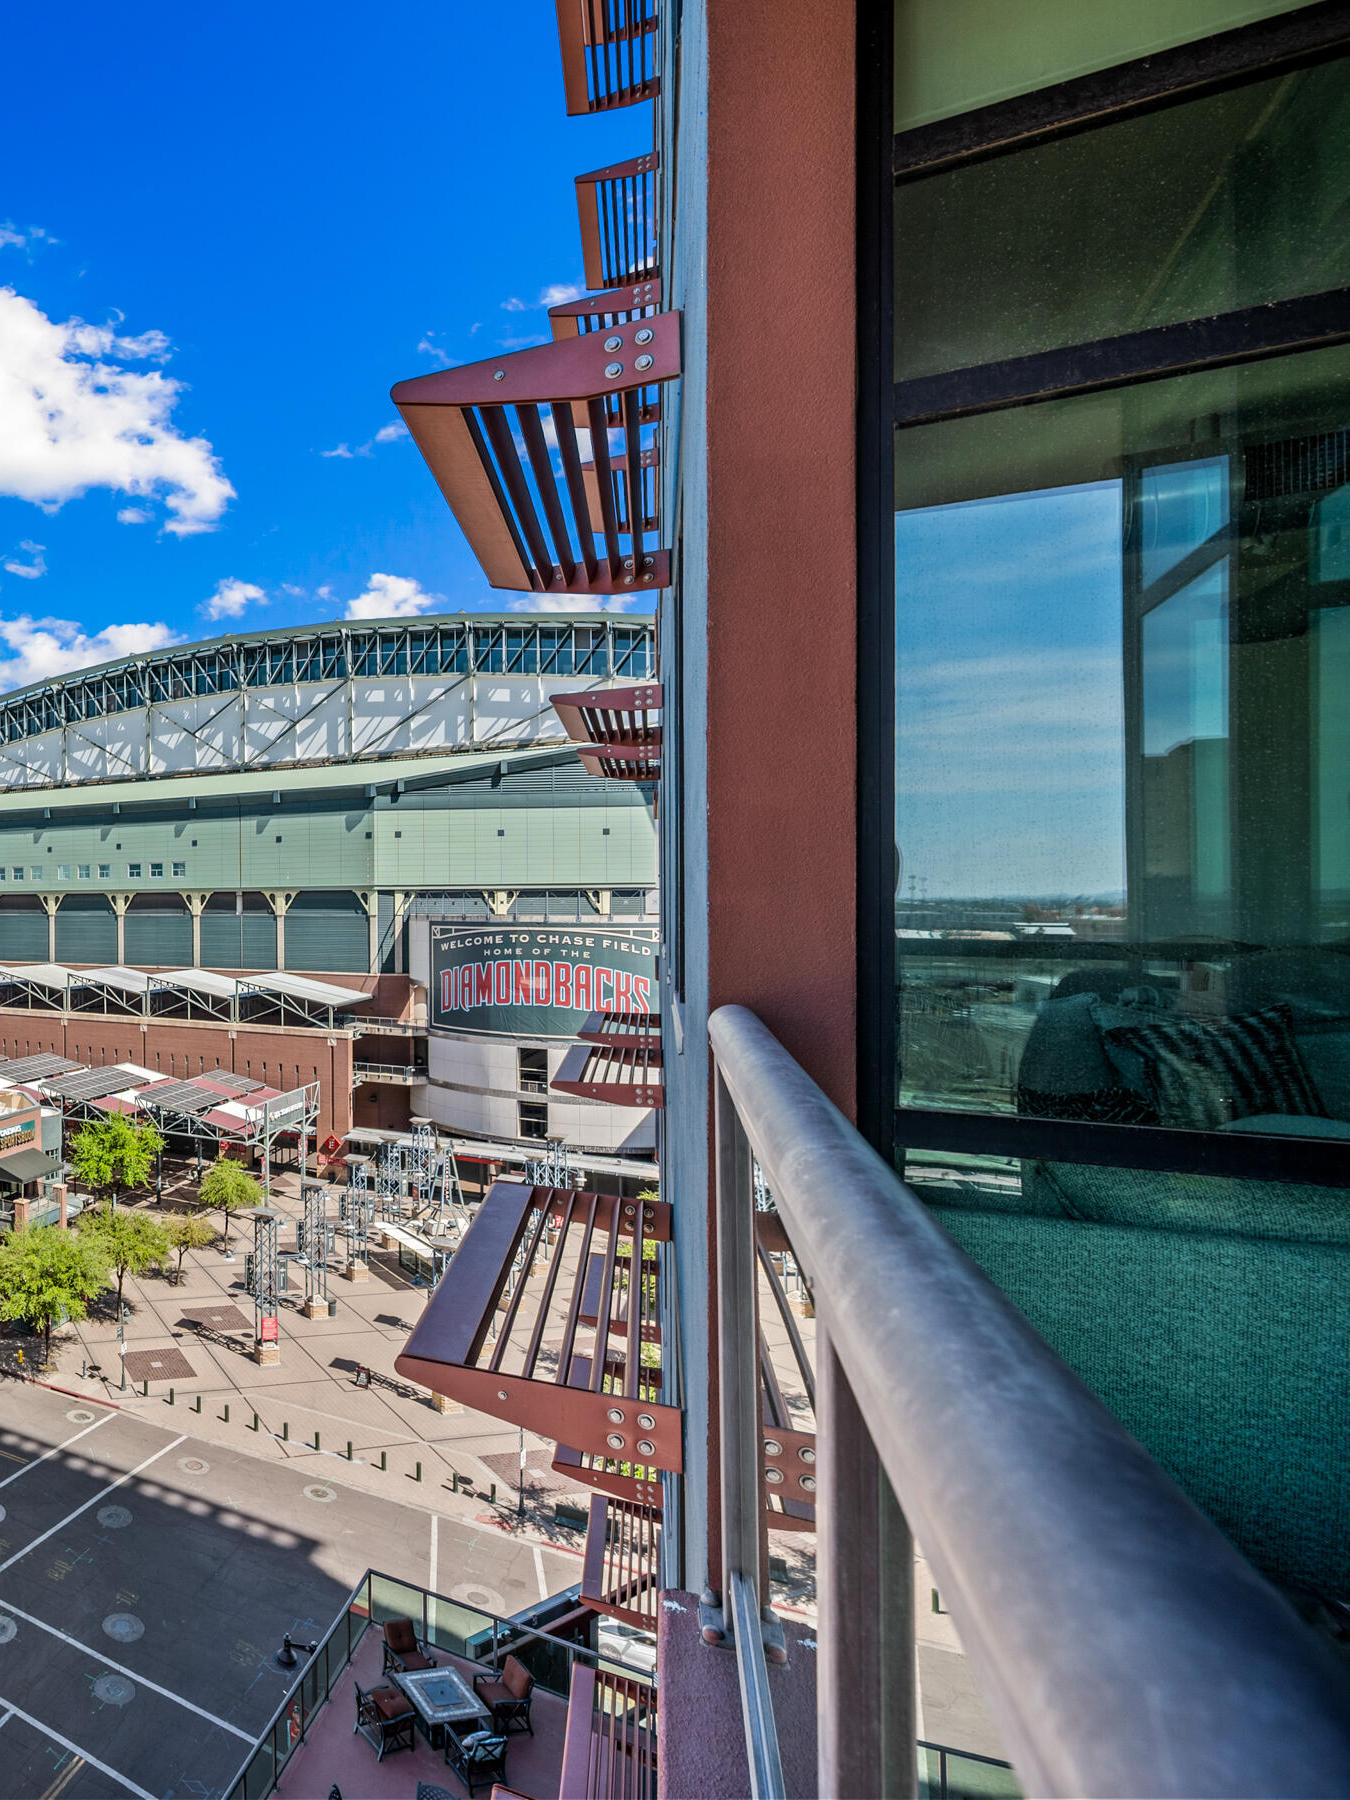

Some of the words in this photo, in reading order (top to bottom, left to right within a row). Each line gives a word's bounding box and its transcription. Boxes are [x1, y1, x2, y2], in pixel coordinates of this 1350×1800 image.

[440, 935, 504, 951] WELCOME
[509, 934, 530, 944] TO
[536, 934, 595, 947] CHASE
[602, 940, 651, 956] FIELD
[483, 948, 523, 956] HOME
[561, 949, 591, 959] THE
[439, 959, 651, 1014] DIAMONDBACKS
